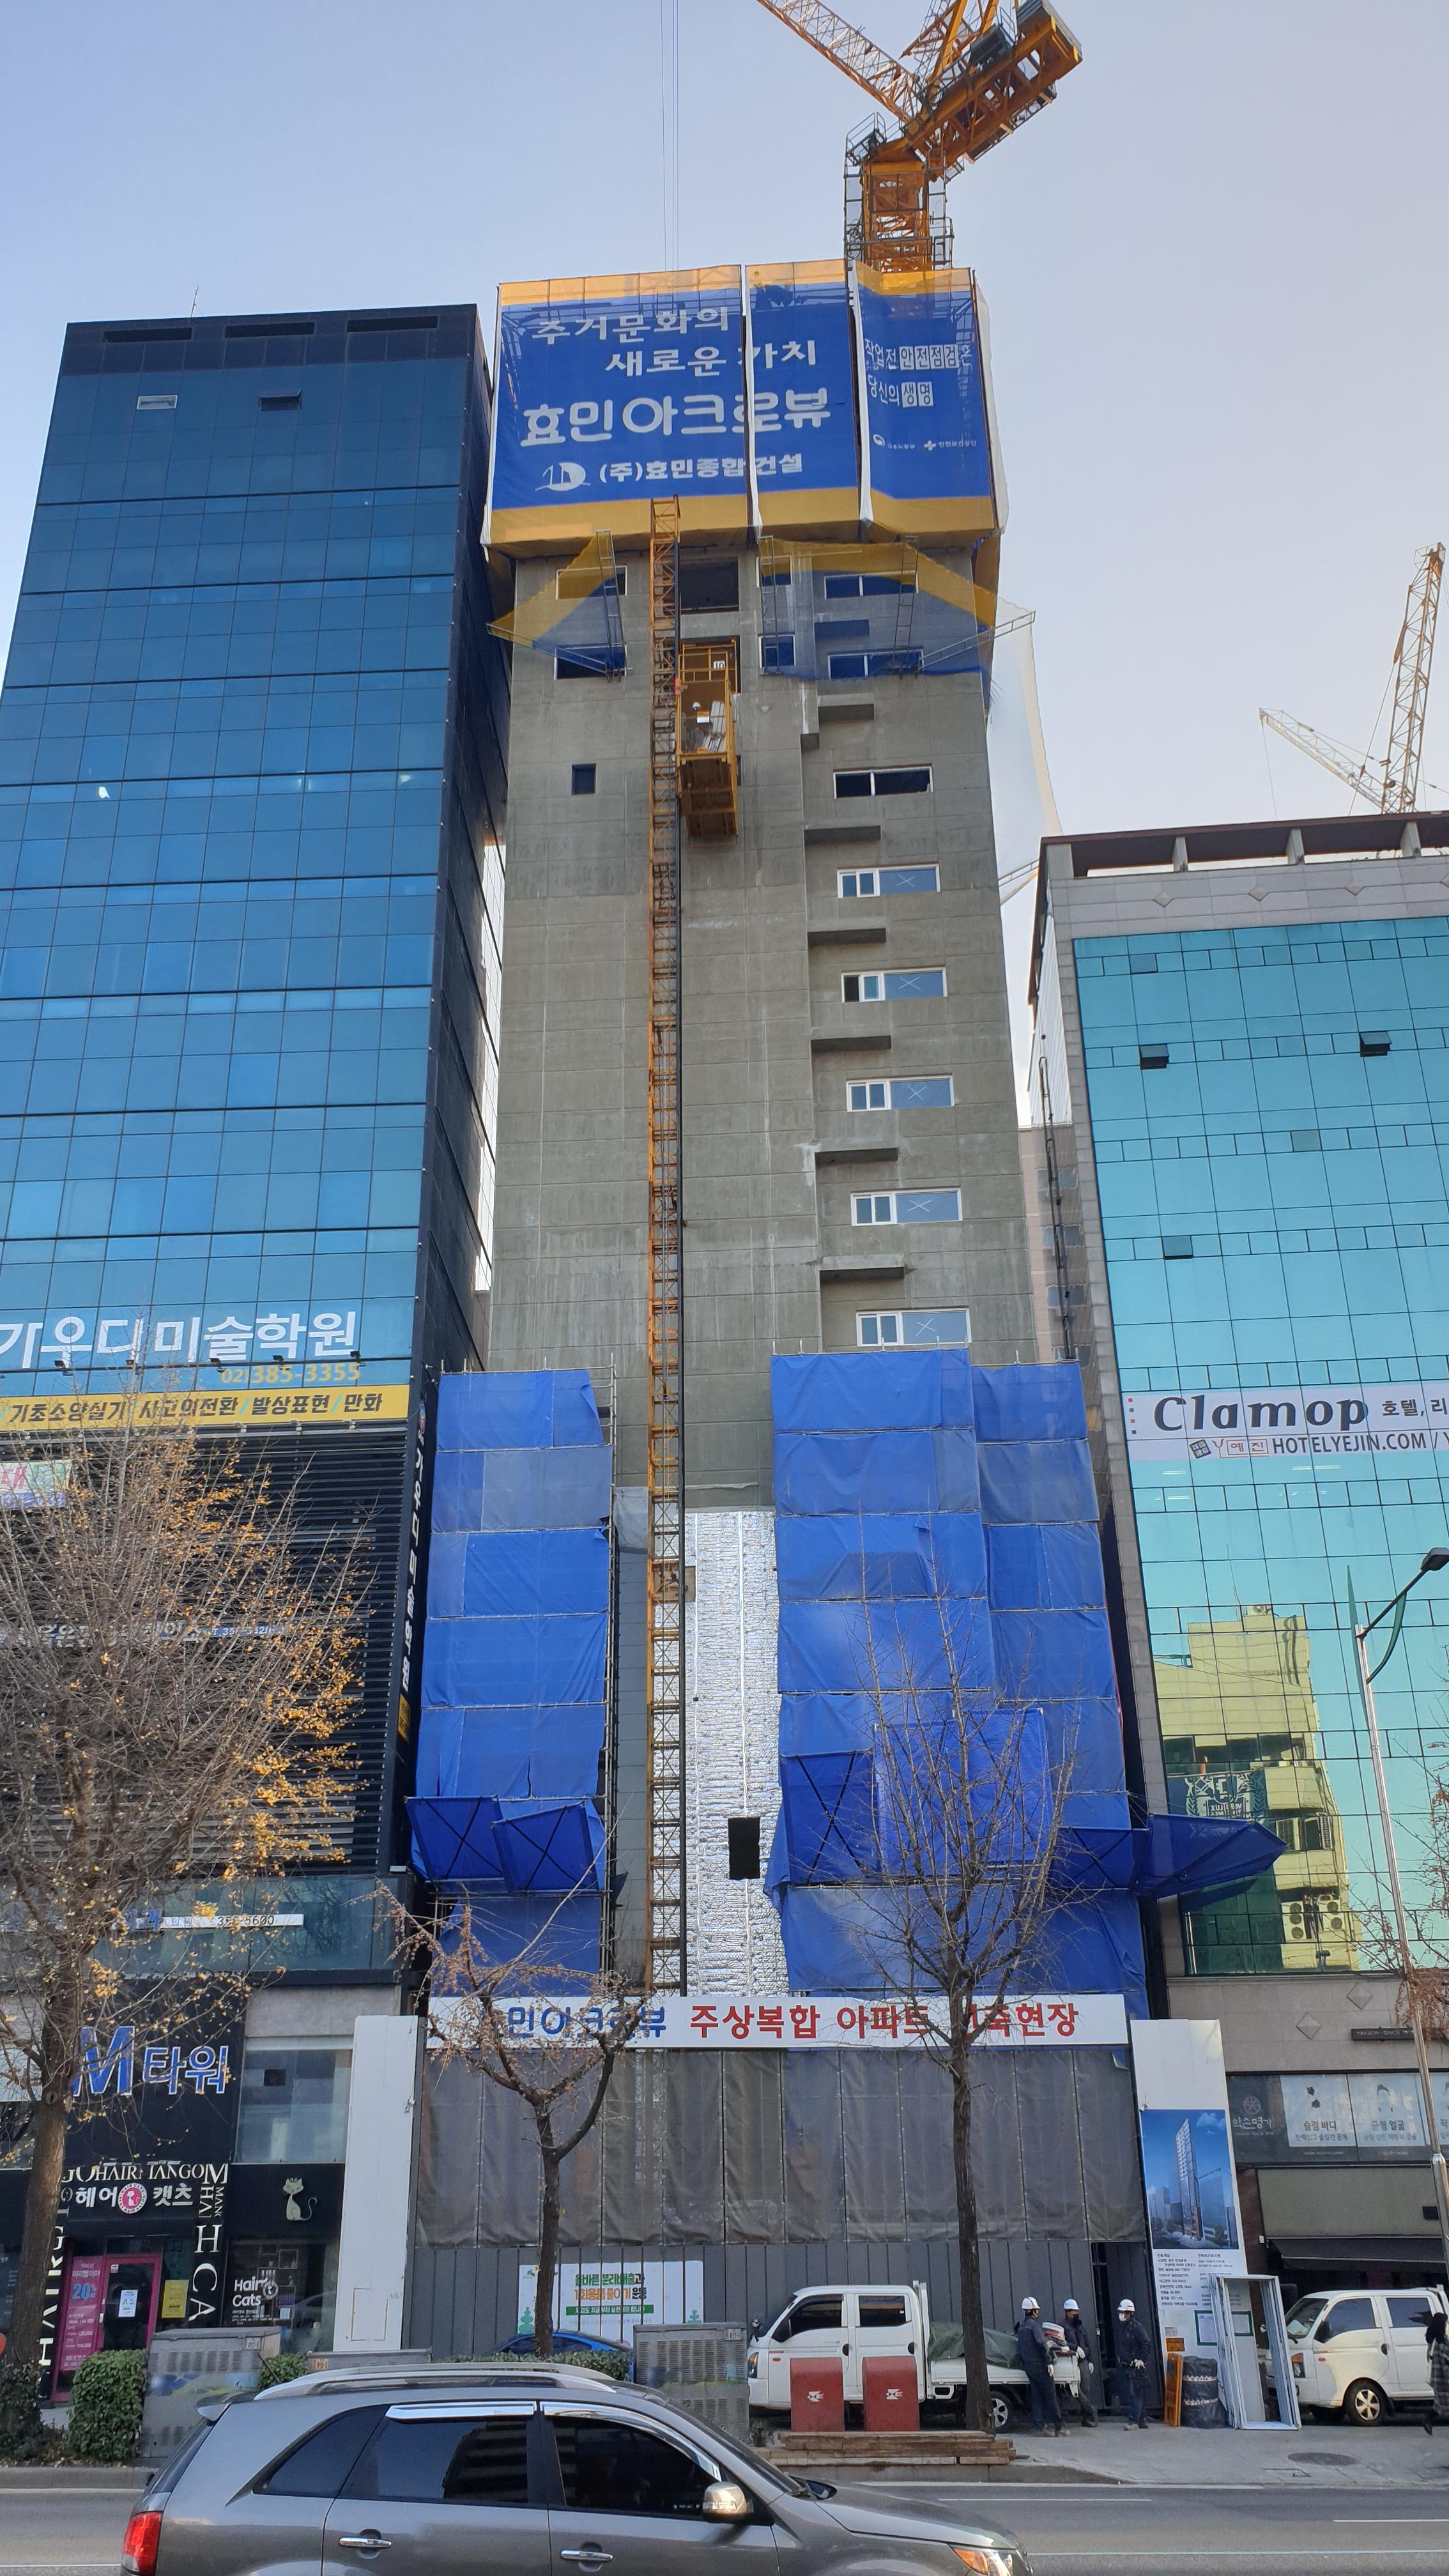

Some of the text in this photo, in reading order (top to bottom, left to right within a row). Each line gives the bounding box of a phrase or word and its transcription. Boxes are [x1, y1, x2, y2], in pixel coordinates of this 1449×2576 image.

[604, 341, 816, 377] 새로운 가치
[868, 374, 933, 408] 당신의 생명
[599, 454, 802, 484] (주)효민종합건설
[0, 1311, 356, 1369] 가우디미술학원
[252, 1395, 332, 1415] 발상표현
[344, 1393, 383, 1413] 만화
[1154, 1394, 1368, 1432] Clamop
[1382, 1399, 1425, 1417] 호텔,
[1230, 1441, 1264, 1453] 예진
[1271, 1432, 1427, 1454] HOTELYEJIN.COM
[690, 2004, 821, 2039] 주상복합
[1232, 2116, 1273, 2129] 약손명가
[1303, 2120, 1337, 2131] 슬림 바디
[1389, 2120, 1405, 2131] 얼굴
[75, 2186, 118, 2208] 헤어
[153, 2183, 194, 2207] 캣츠
[234, 2276, 268, 2292] Hair
[632, 2287, 647, 2300] 운동
[232, 2294, 261, 2308] Cats
